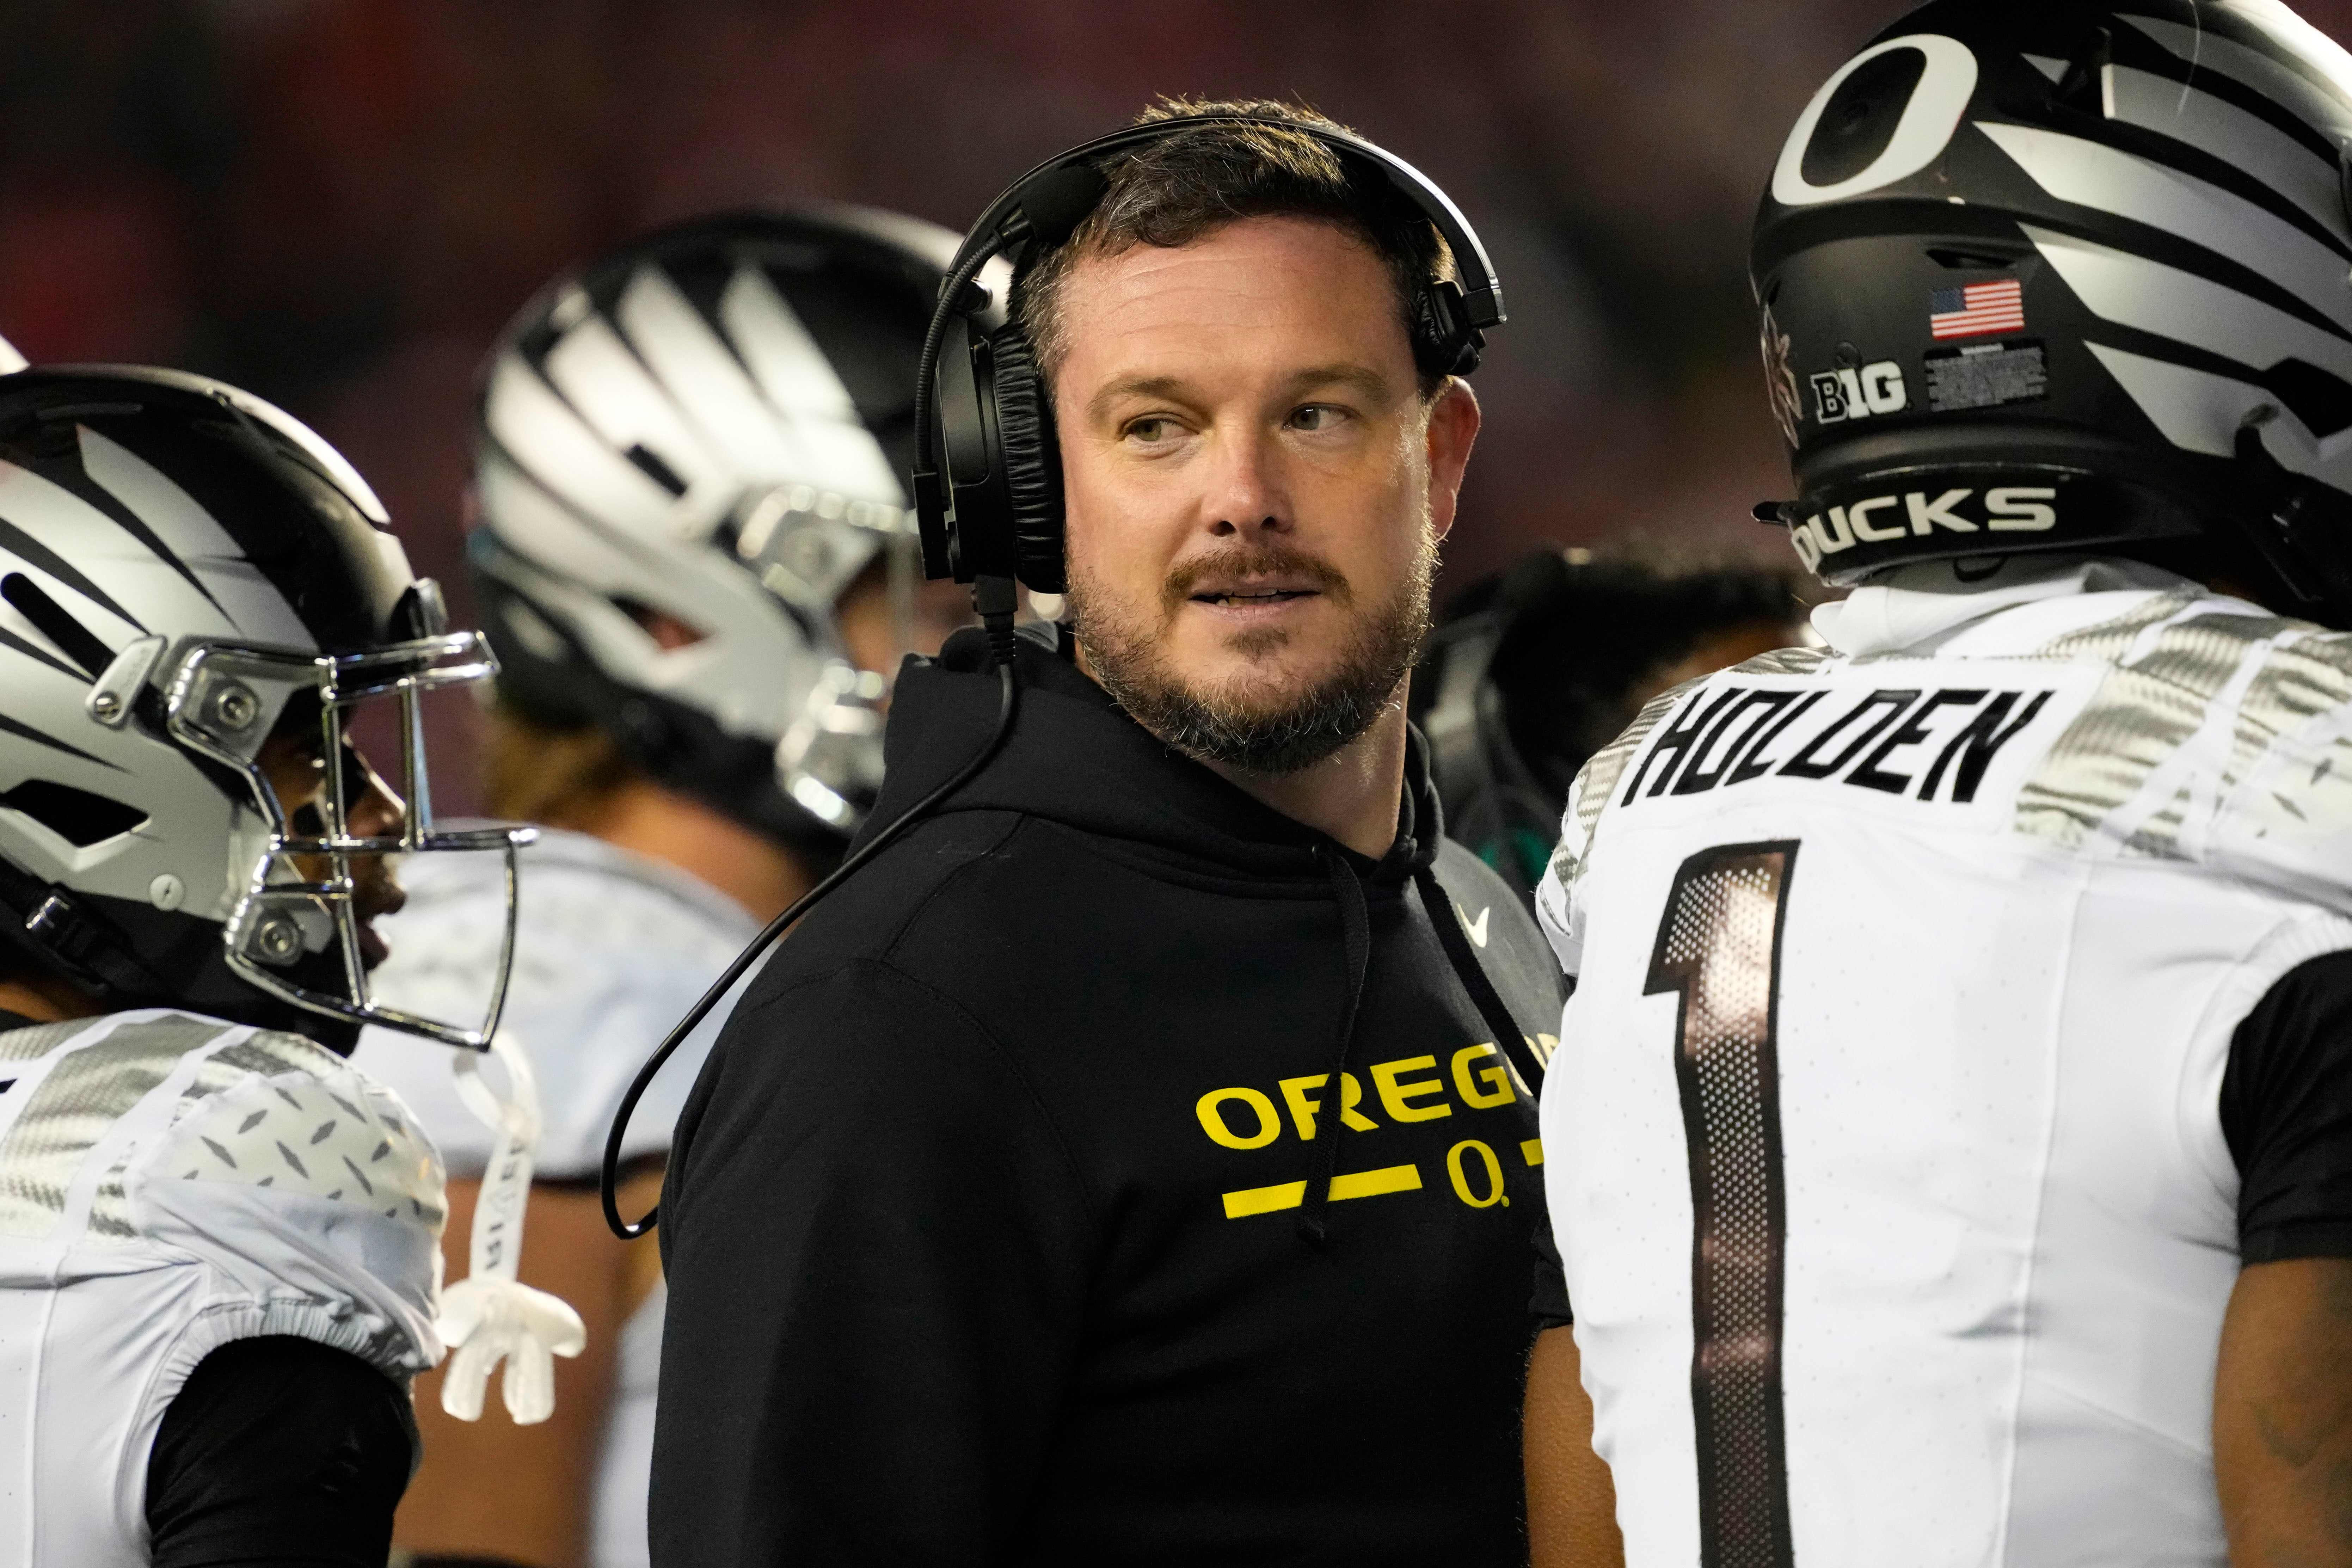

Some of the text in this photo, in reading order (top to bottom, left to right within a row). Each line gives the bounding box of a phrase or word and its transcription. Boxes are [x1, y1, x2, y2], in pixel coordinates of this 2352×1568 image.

[1771, 33, 1979, 206] O
[1791, 488, 2056, 574] DUCKS
[1621, 687, 2055, 808] HOLDEN
[1196, 1033, 1560, 1150] OREG
[1642, 838, 1801, 1568] 1
